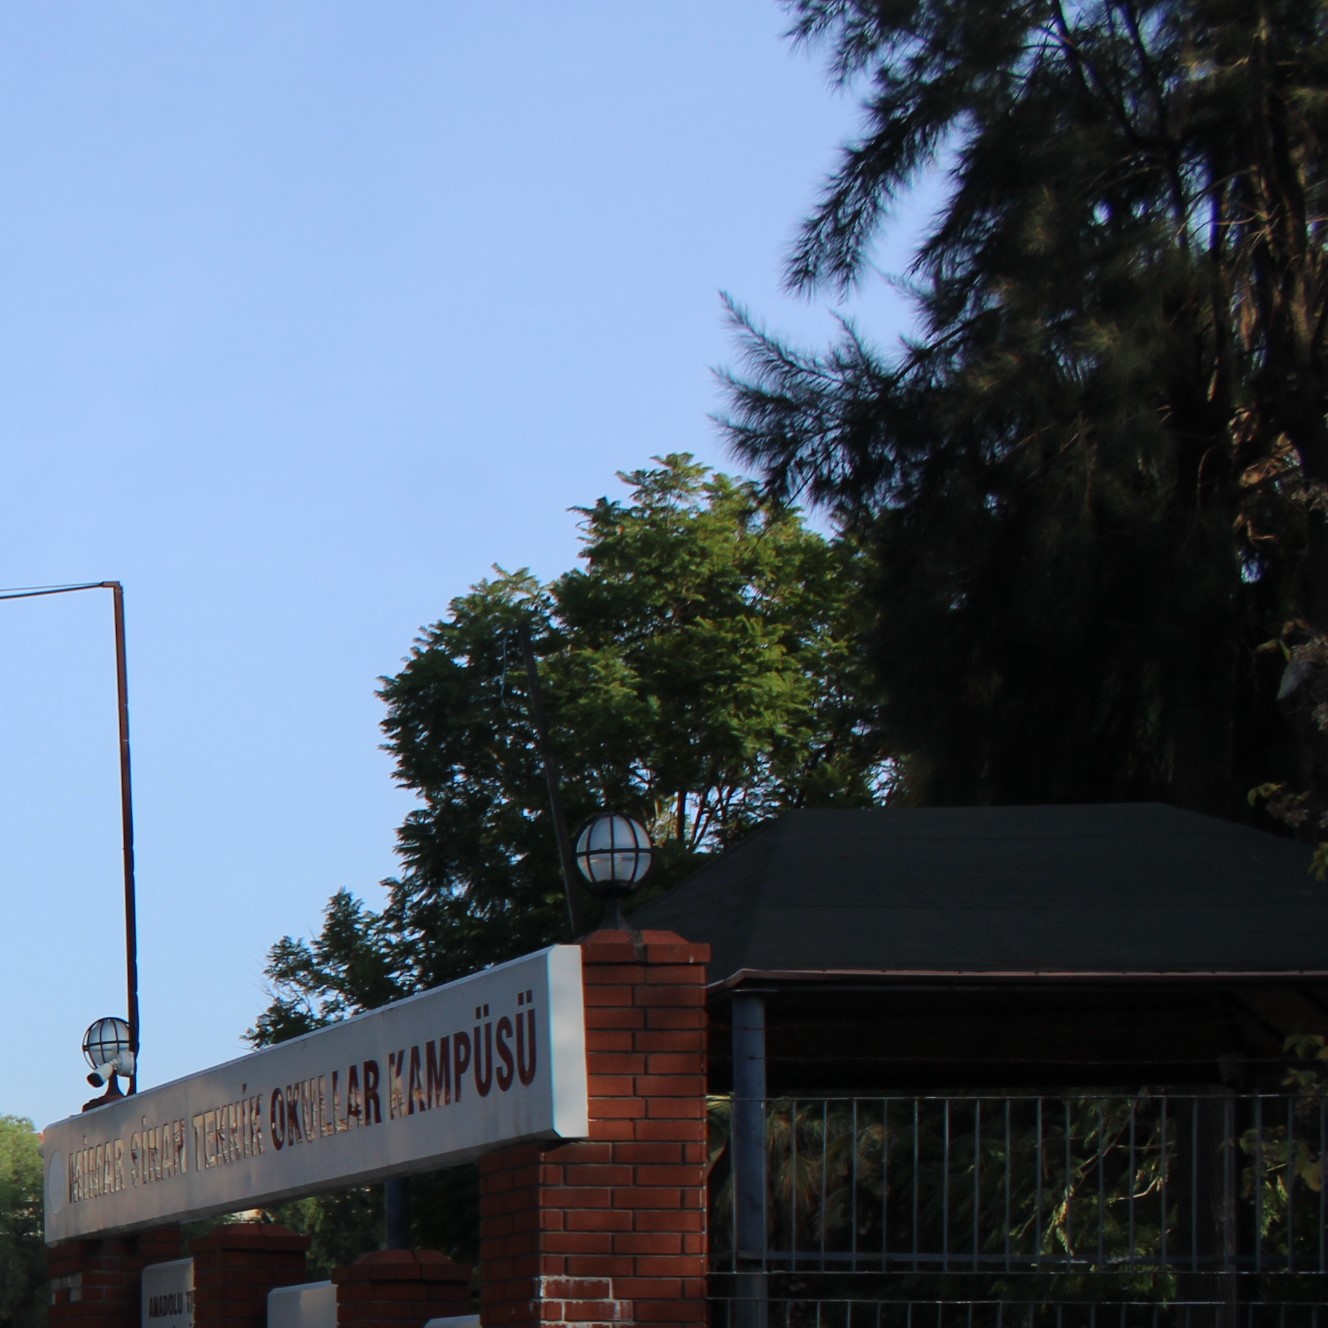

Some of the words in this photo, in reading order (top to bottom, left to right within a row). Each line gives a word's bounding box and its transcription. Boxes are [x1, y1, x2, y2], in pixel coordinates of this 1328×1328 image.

[68, 1135, 125, 1203] MİMAR
[130, 1115, 186, 1188] SİNAN
[192, 1084, 266, 1171] TEKNİK
[270, 1060, 382, 1151] OKULLAR
[388, 989, 537, 1120] KAMPÜSÜ
[148, 1292, 183, 1318] ANADOLU
